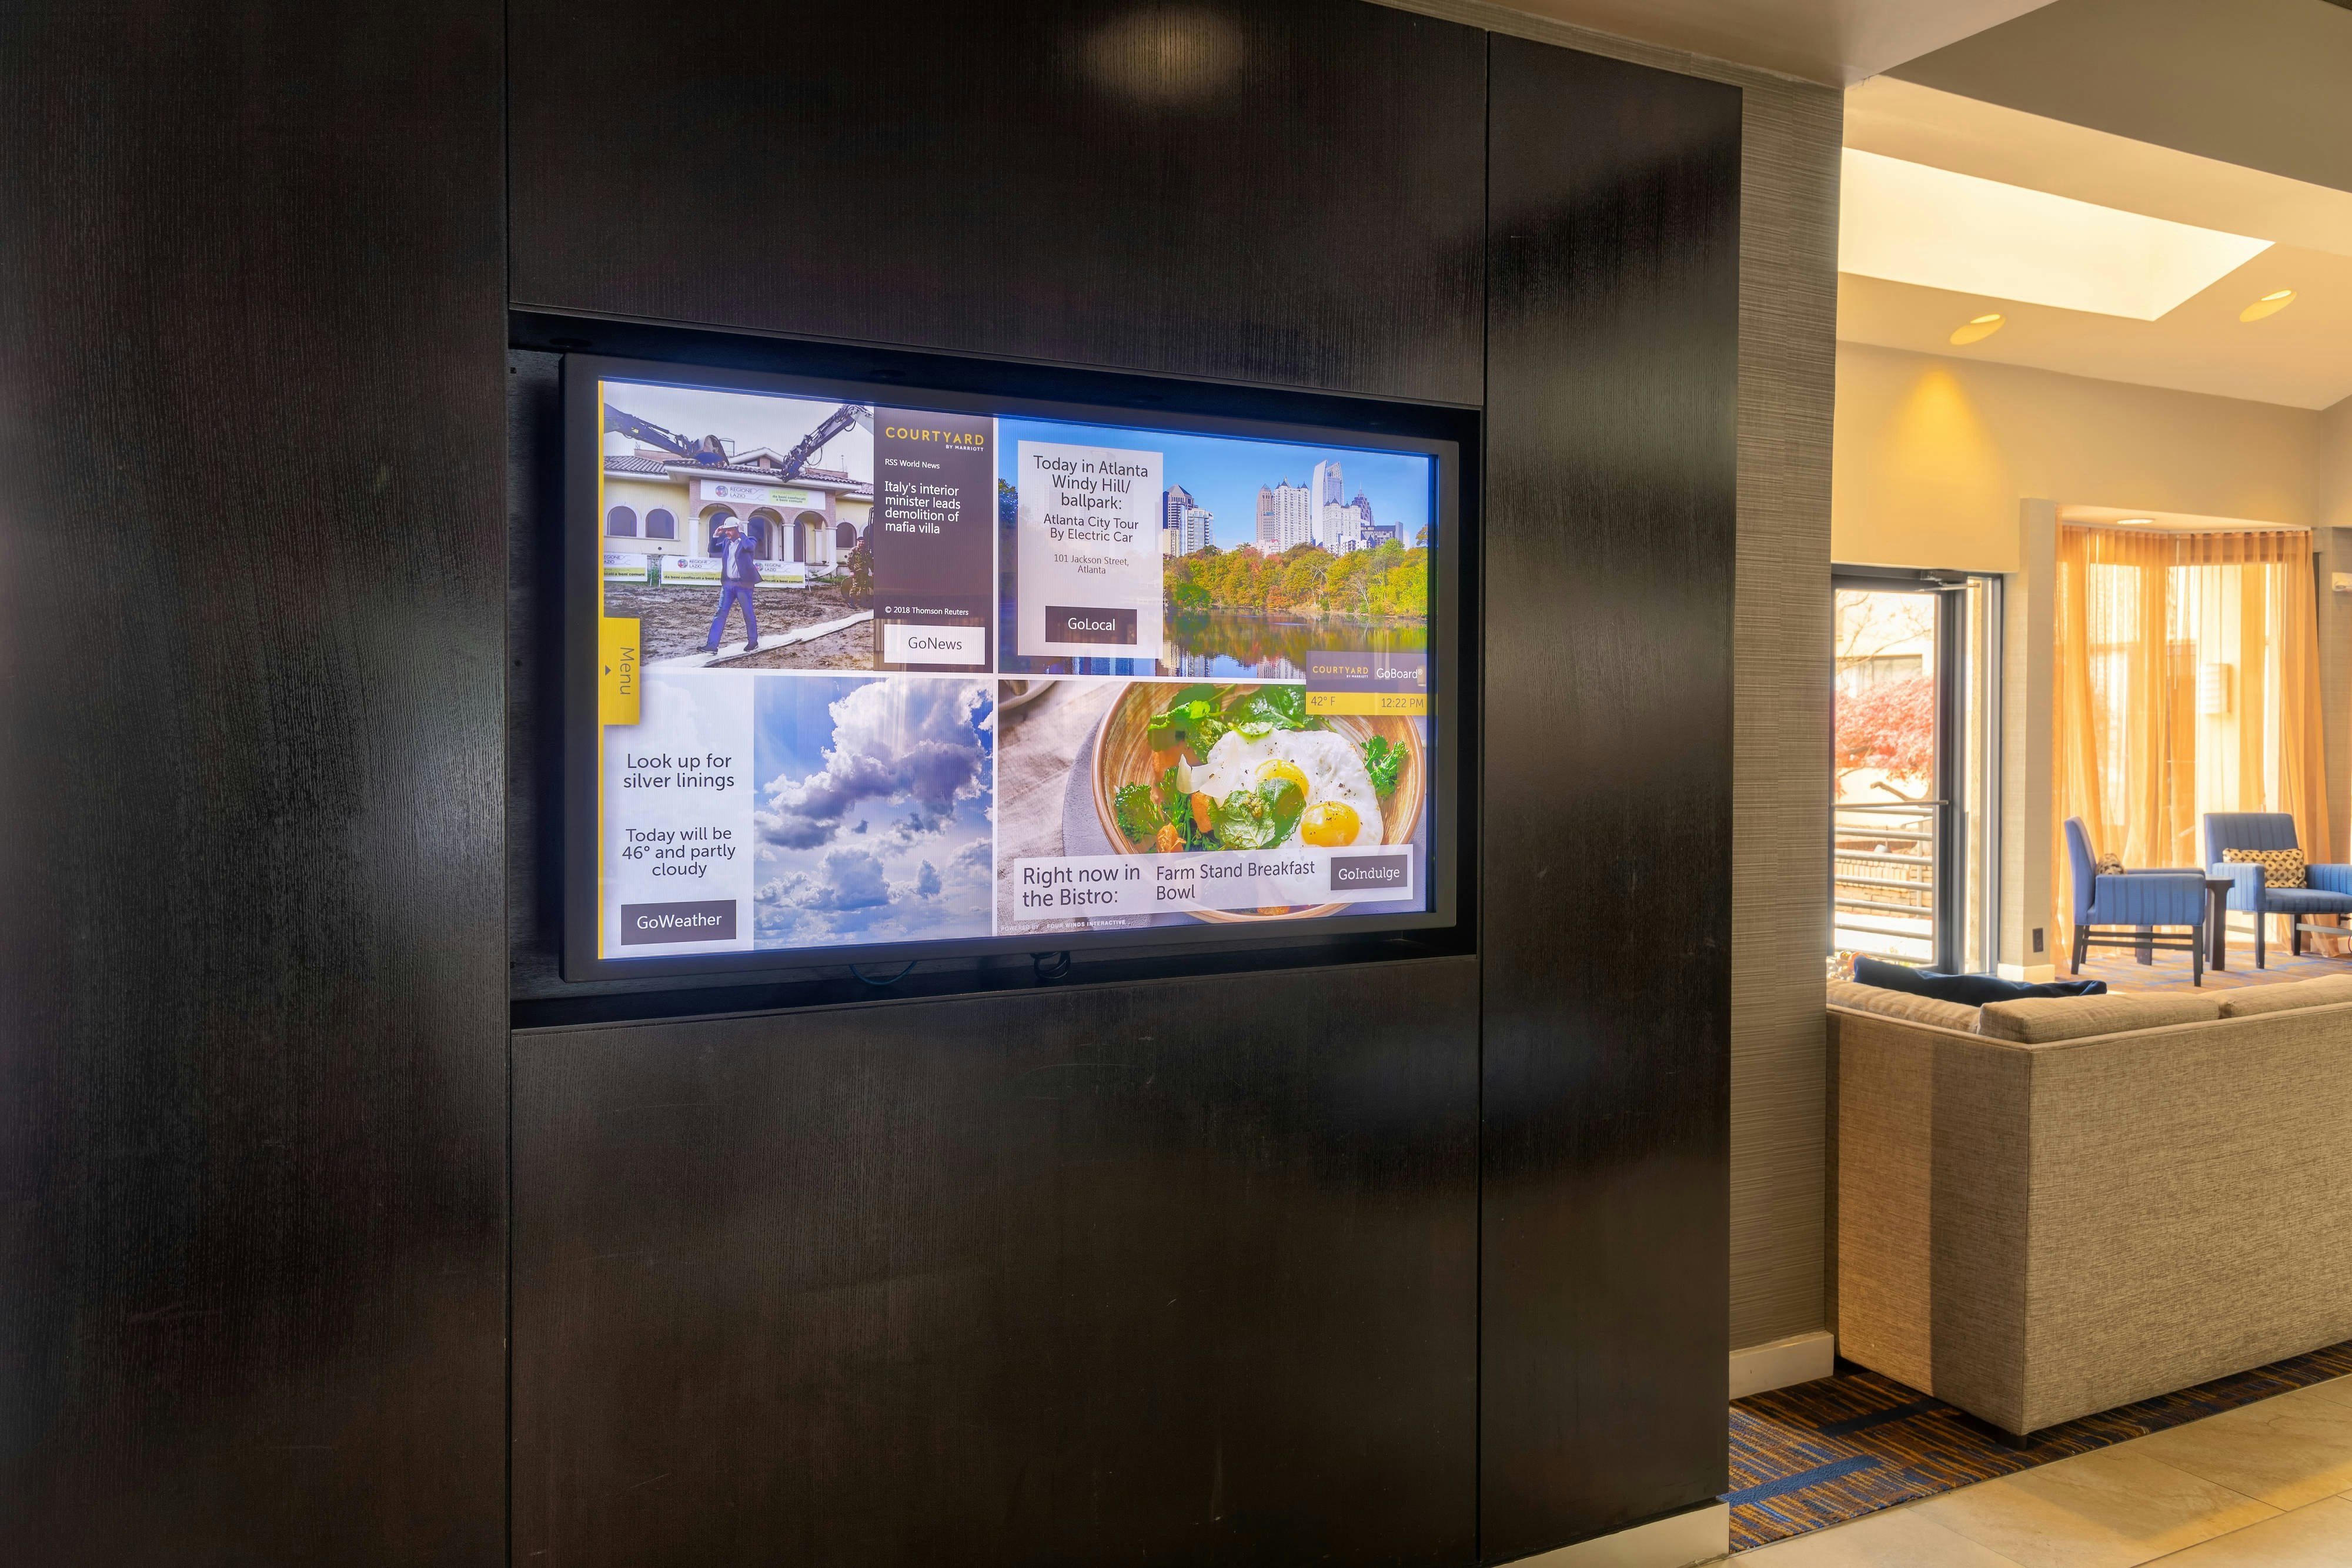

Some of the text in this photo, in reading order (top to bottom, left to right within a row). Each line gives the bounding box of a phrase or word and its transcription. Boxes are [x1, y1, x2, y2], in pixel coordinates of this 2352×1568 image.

[886, 427, 984, 445] COURTYARD
[1033, 455, 1148, 477] Today in Atlanta
[884, 481, 959, 496] Italy's interior
[1052, 474, 1131, 494] Windy Hill/
[886, 495, 961, 509] minister leads
[1061, 492, 1122, 510] ballpark:
[885, 507, 960, 521] demolition of
[1043, 513, 1139, 530] Atlanta City Tour
[885, 521, 940, 534] mafia villa
[1050, 527, 1133, 543] By Electric Car
[1054, 554, 1129, 567] 101 Jackson Street,
[1077, 566, 1106, 574] Atlanta
[1068, 617, 1115, 631] GoLocal
[908, 637, 962, 650] GoNews
[619, 647, 634, 695] Menu
[1312, 666, 1369, 674] COURTYARD
[1311, 696, 1336, 706] 42° F
[1381, 698, 1424, 708] 12:22 PM
[627, 753, 732, 771] Look up for
[623, 773, 735, 791] silver linings
[626, 826, 733, 845] Today will be
[622, 843, 736, 860] 46° and partly
[652, 861, 707, 878] cloudy
[1023, 864, 1140, 888] Right now in
[1157, 861, 1315, 881] Farm Stand Breakfast
[1338, 865, 1400, 881] GoIndulge
[1023, 887, 1118, 907] the Bistro:
[1157, 884, 1195, 900] Bowl
[636, 912, 722, 930] GoWeather
